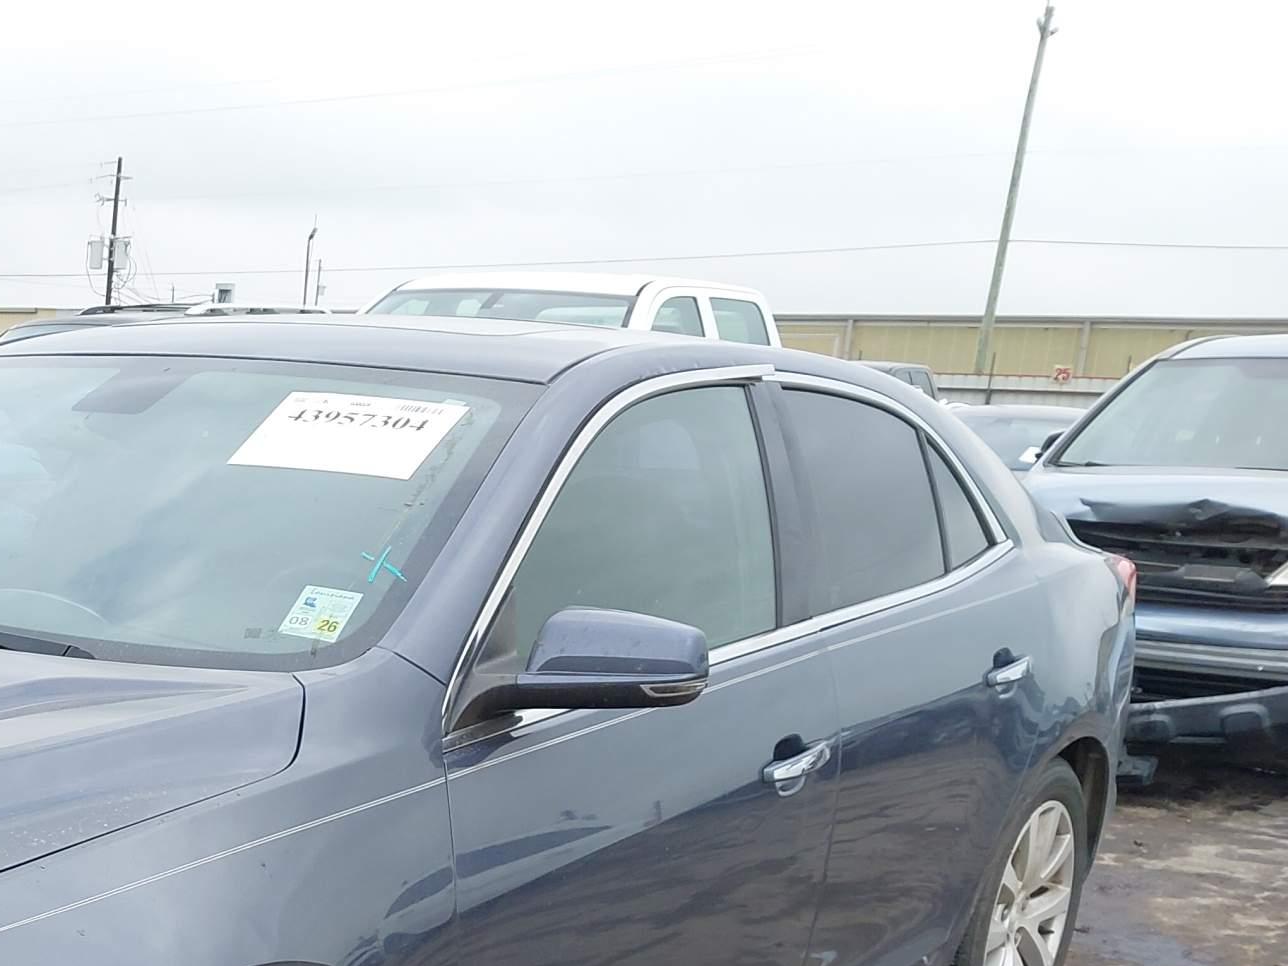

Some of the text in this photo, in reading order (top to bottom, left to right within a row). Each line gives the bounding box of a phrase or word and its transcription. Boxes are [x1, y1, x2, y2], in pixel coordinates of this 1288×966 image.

[288, 408, 430, 431] 43957304
[289, 616, 310, 626] 08
[317, 619, 340, 633] 26
